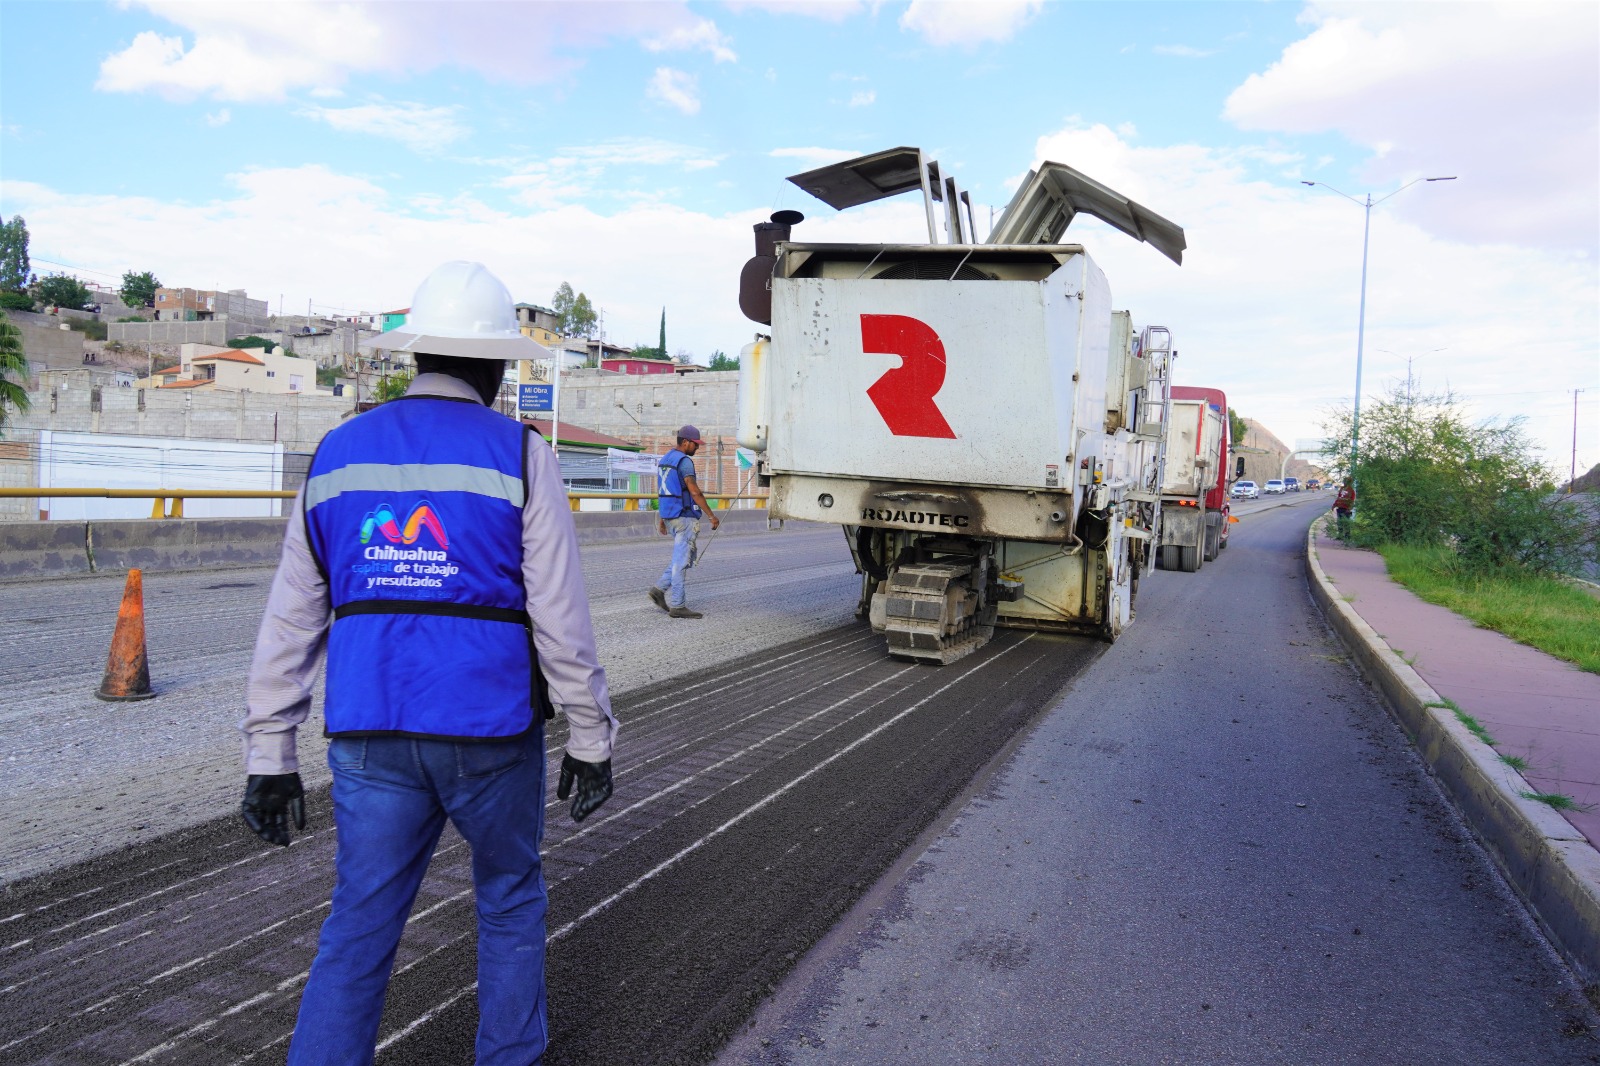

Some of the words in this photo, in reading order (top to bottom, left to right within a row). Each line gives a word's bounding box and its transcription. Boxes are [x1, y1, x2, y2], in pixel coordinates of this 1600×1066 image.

[862, 508, 969, 527] ROADTEC
[364, 545, 447, 561] Chihuahua
[351, 561, 392, 574] capital
[394, 562, 411, 573] de
[413, 563, 459, 577] trabajo
[366, 577, 376, 589] y
[376, 575, 443, 588] resultados
